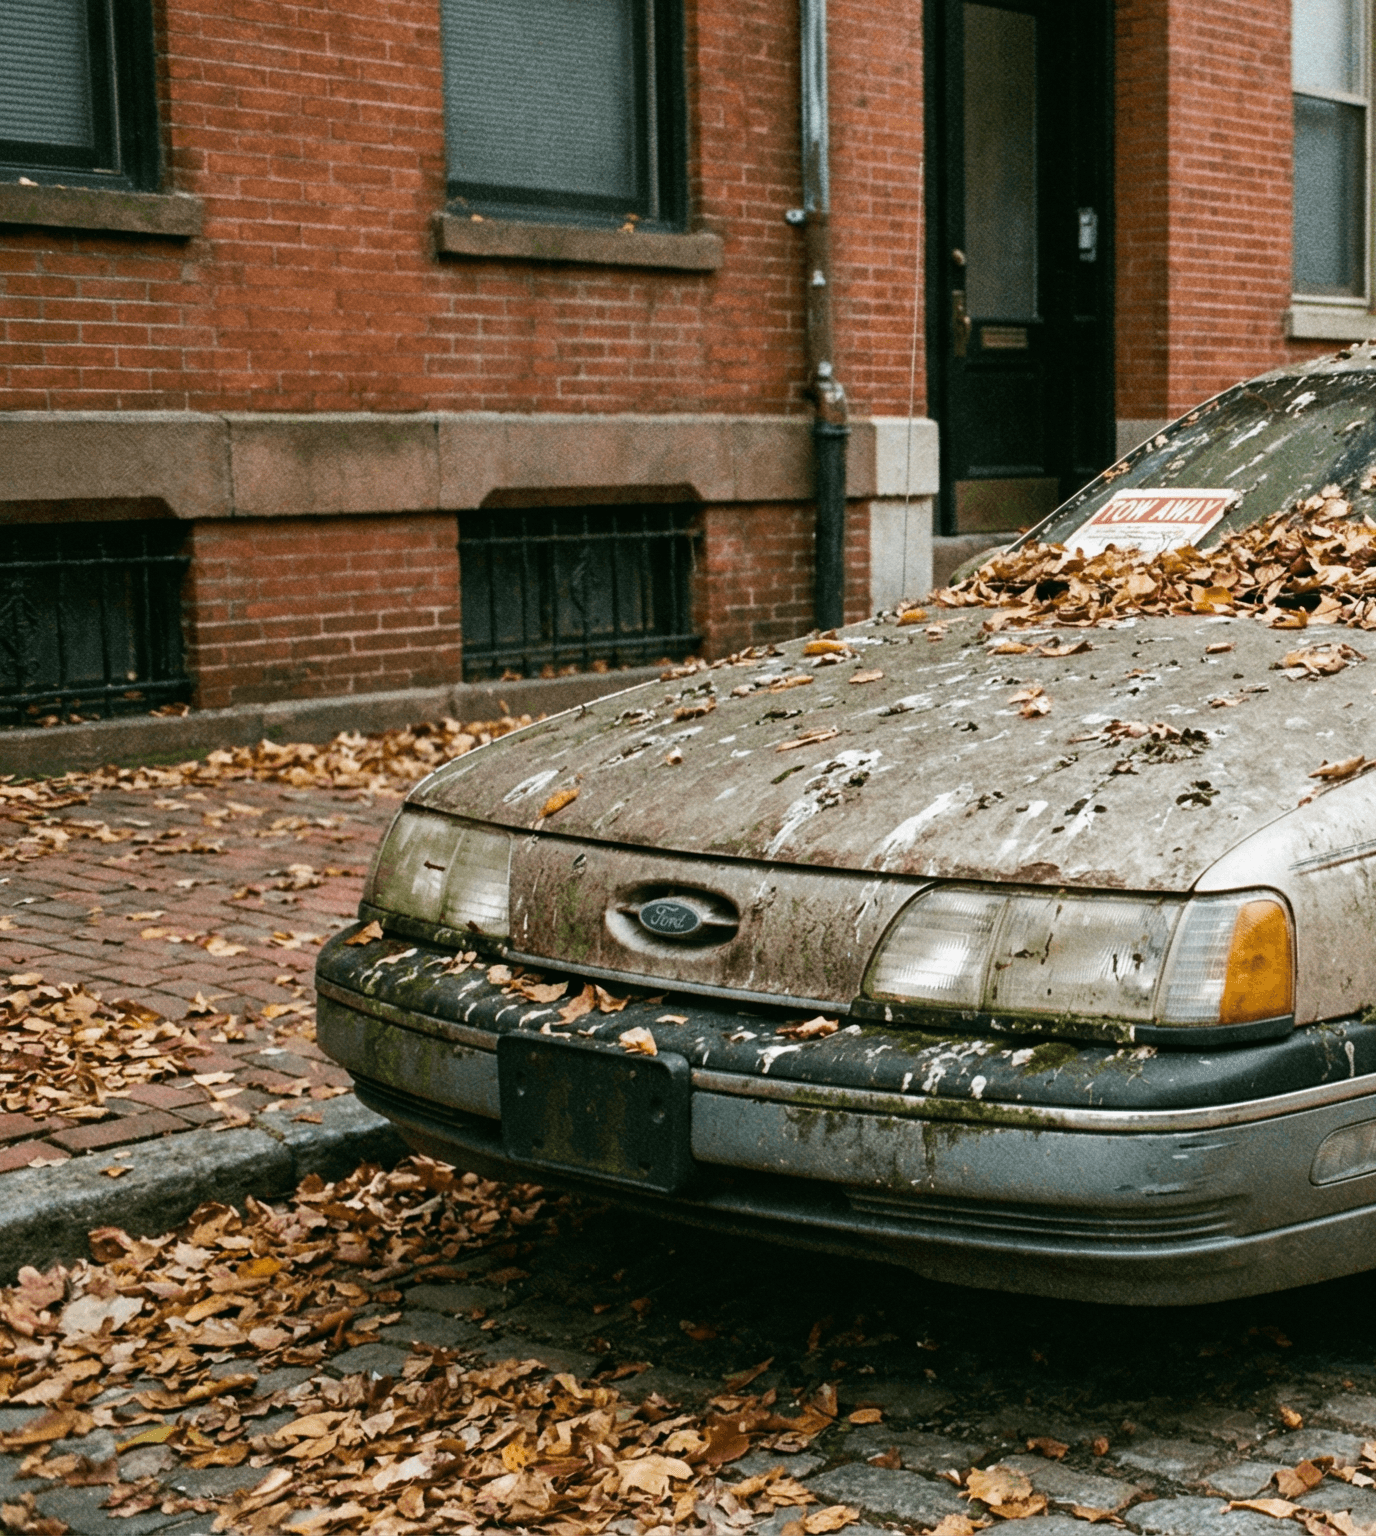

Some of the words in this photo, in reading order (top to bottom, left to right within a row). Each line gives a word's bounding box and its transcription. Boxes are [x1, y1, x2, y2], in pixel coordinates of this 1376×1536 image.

[1100, 499, 1160, 522] TOW
[1148, 499, 1223, 522] AWAY
[650, 905, 687, 929] Ford
